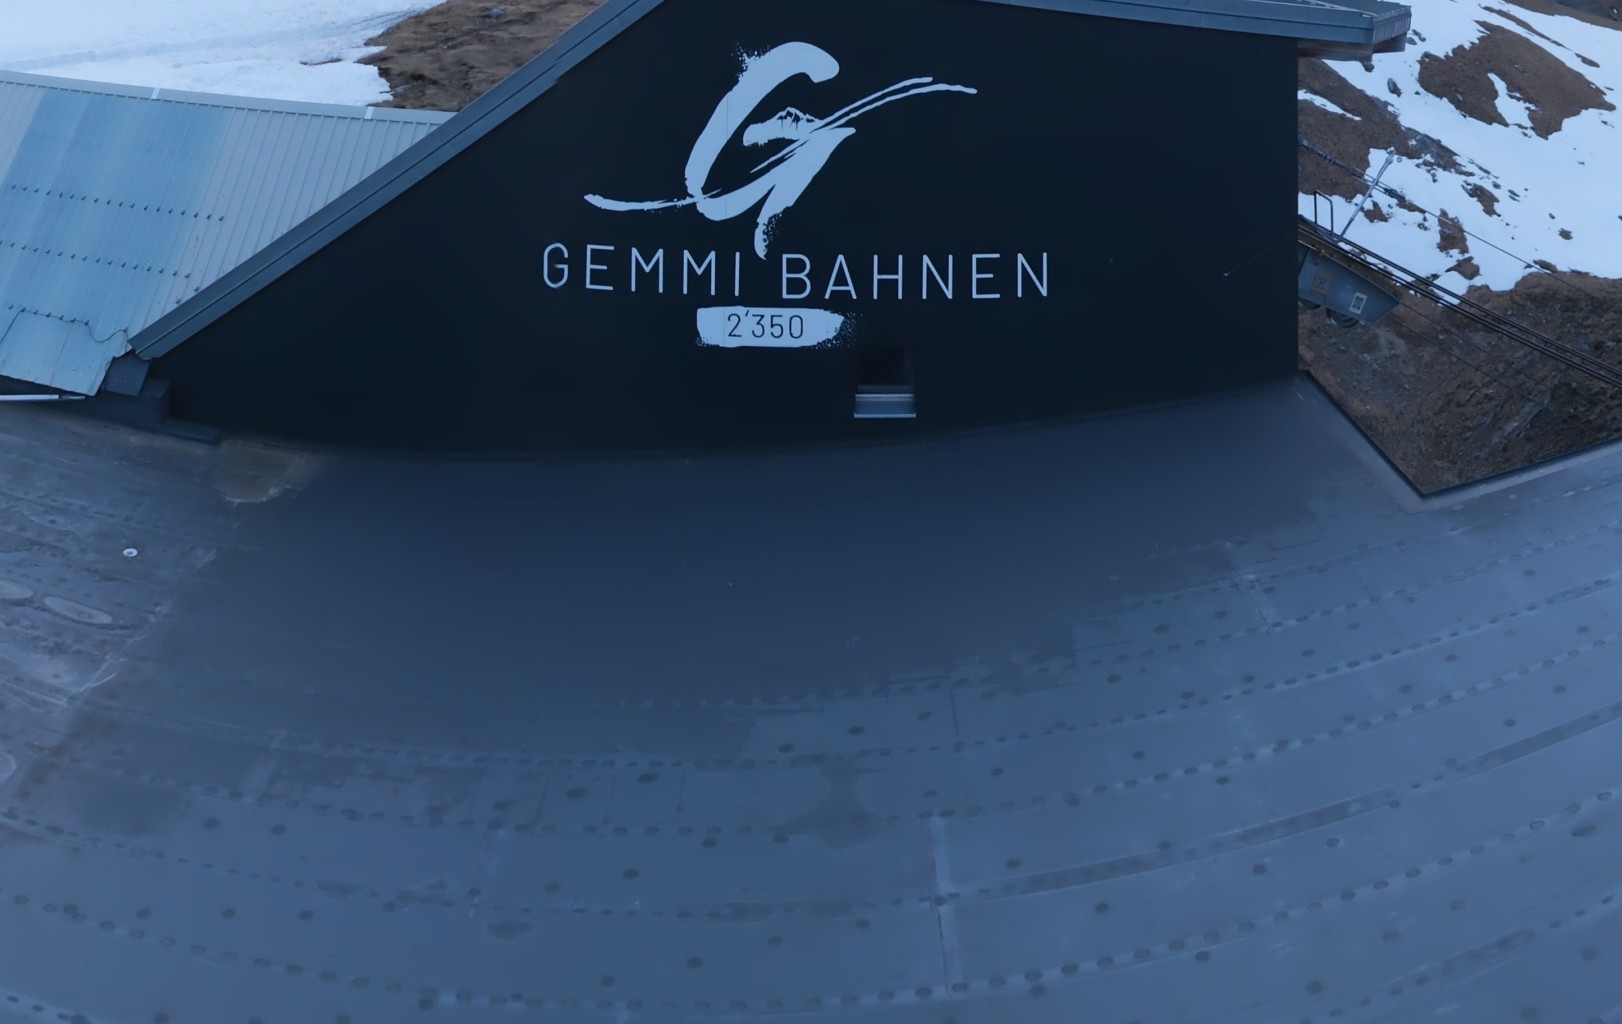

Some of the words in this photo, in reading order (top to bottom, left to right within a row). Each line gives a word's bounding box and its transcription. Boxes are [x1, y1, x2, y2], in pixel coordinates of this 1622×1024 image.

[542, 242, 741, 297] GEMMI
[781, 252, 1049, 301] BAHNEN
[726, 308, 806, 340] 2'350
